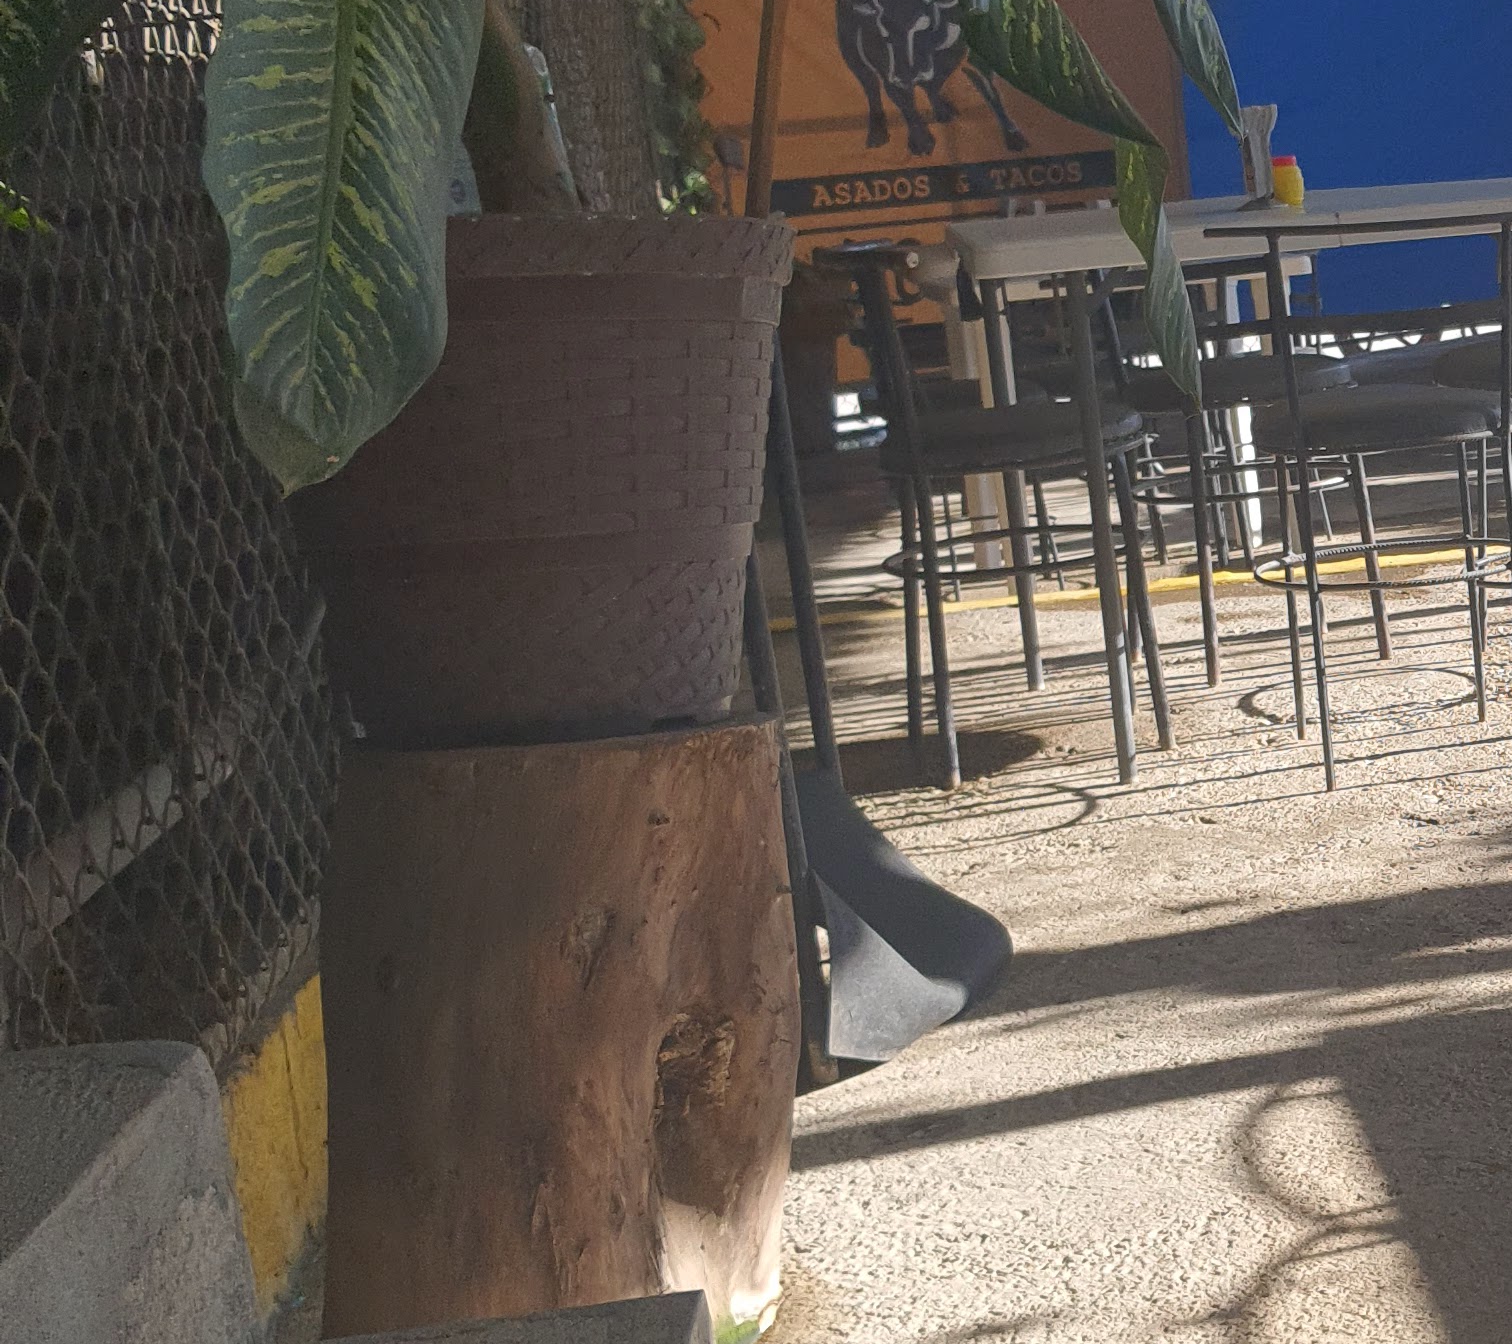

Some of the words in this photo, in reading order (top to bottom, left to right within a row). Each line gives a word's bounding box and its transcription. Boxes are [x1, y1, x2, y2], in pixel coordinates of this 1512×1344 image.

[812, 174, 931, 207] ASADOS
[956, 173, 971, 194] &
[989, 161, 1083, 190] TACOS
